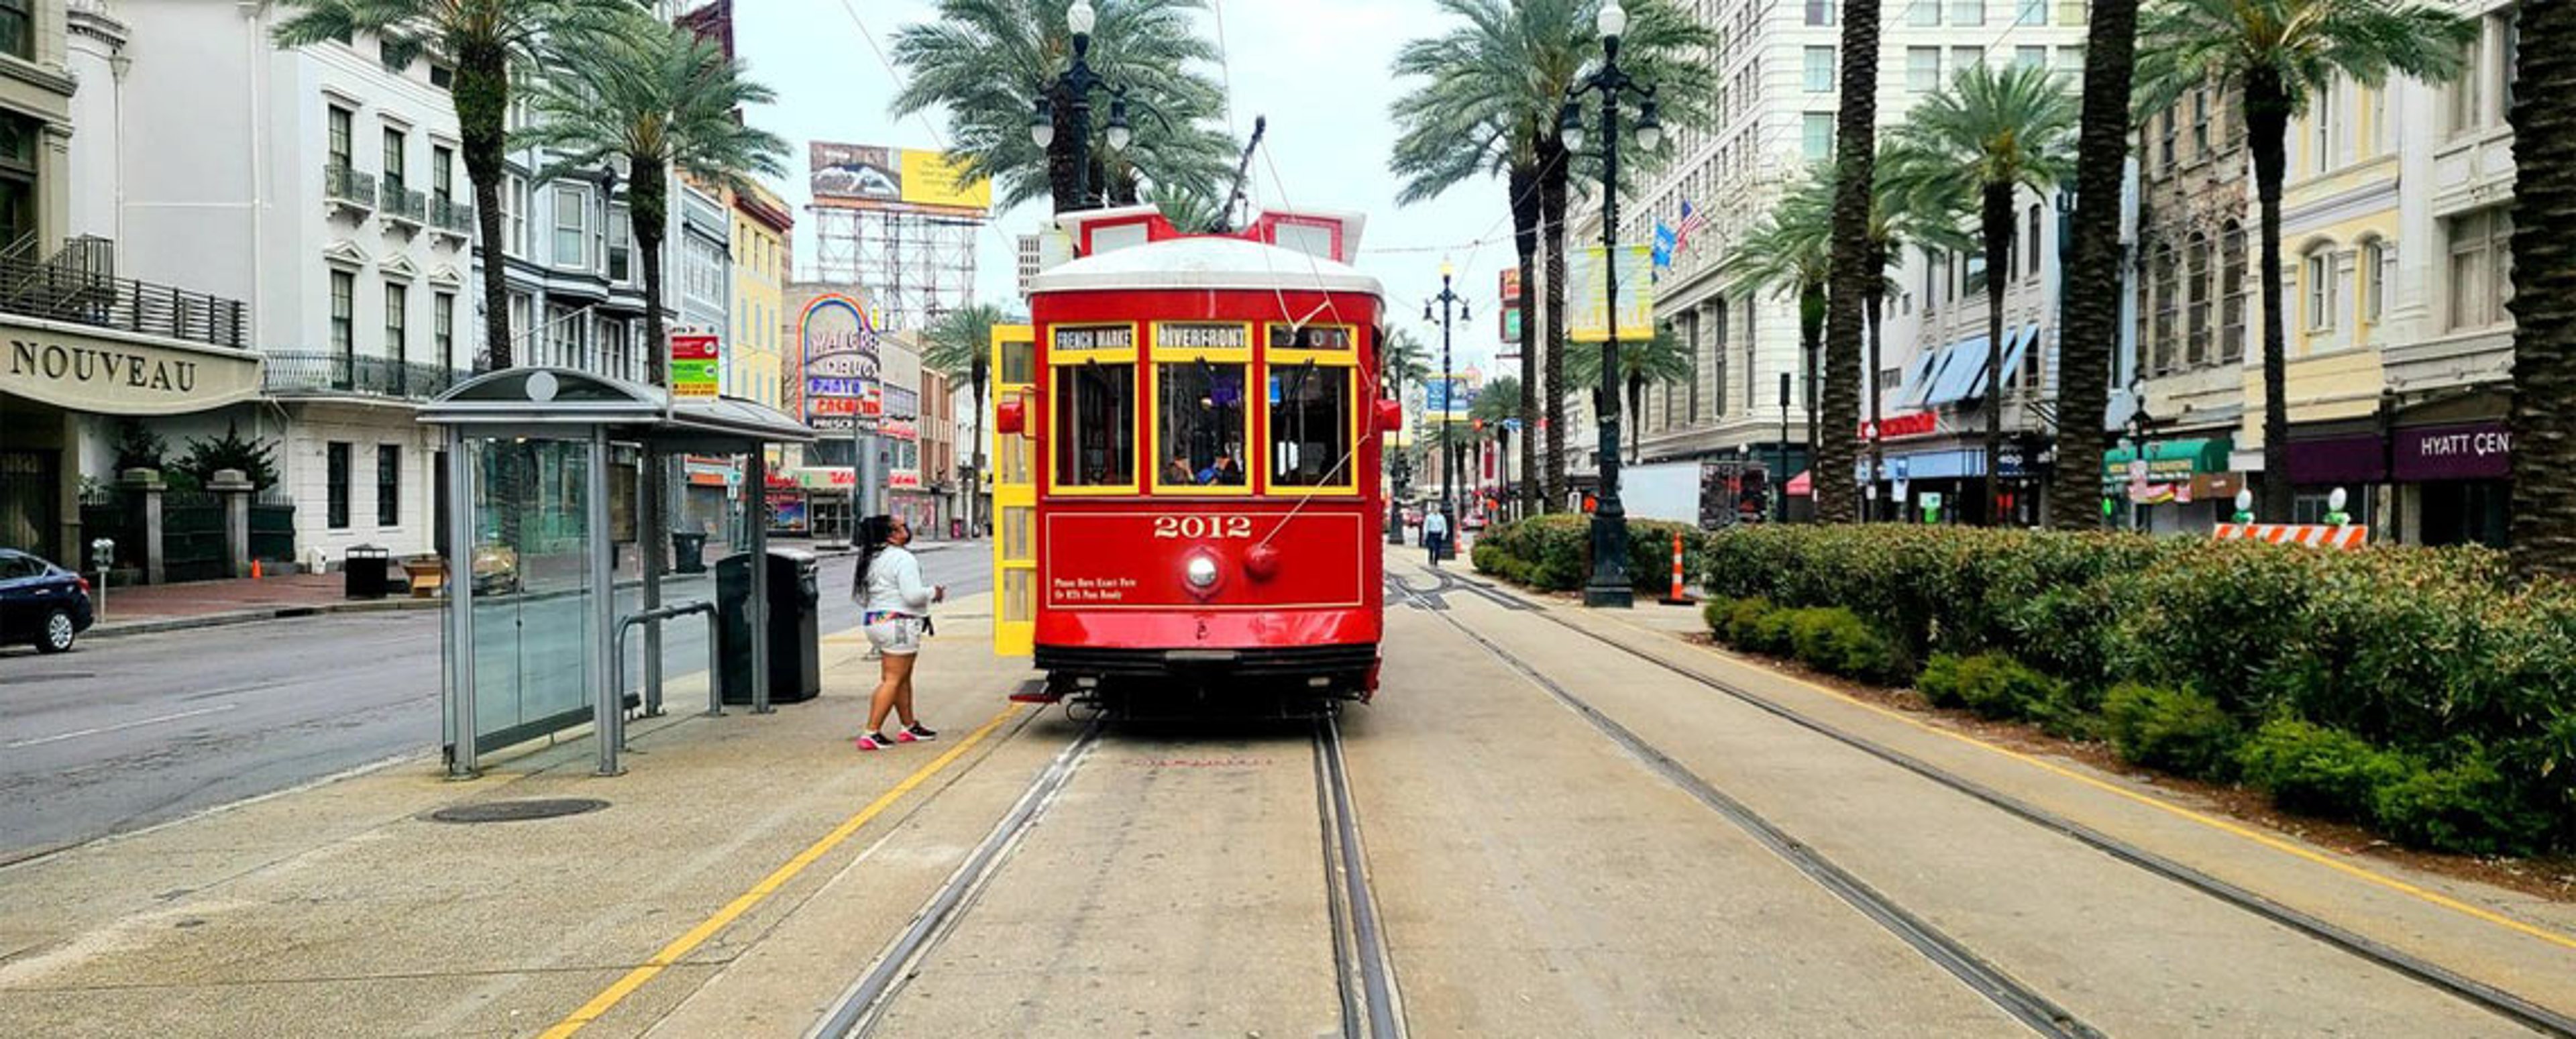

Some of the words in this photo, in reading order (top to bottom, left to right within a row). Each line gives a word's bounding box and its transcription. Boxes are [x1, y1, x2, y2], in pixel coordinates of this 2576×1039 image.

[1095, 329, 1131, 347] MARKE
[1158, 325, 1244, 347] RIVERFRONT
[9, 340, 197, 392] NOUVEAU
[2421, 434, 2471, 456] HYATT
[1154, 516, 1251, 538] 2012
